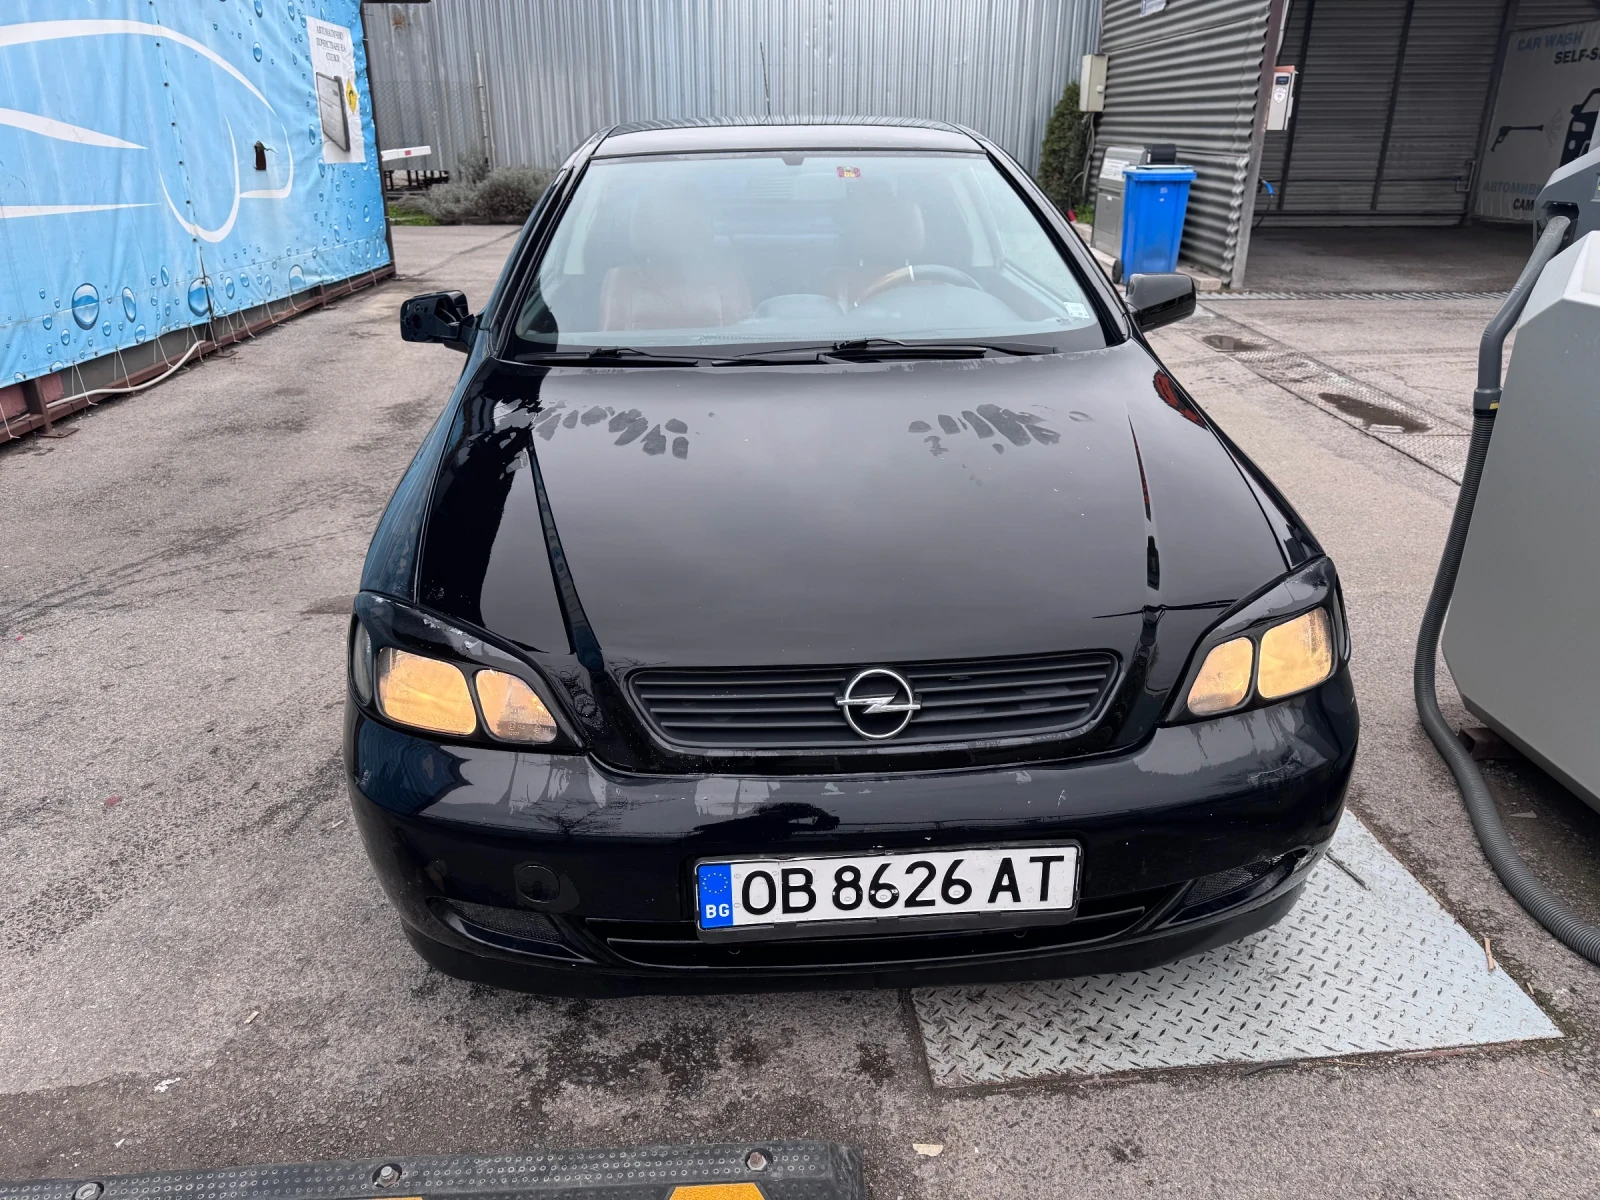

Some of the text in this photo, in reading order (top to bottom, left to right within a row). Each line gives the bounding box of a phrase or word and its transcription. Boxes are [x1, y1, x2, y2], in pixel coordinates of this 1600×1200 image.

[1517, 31, 1583, 51] CAR WASH
[1554, 47, 1600, 64] SELF-S
[741, 855, 1065, 915] OB 8626 AT
[705, 904, 730, 919] BG
